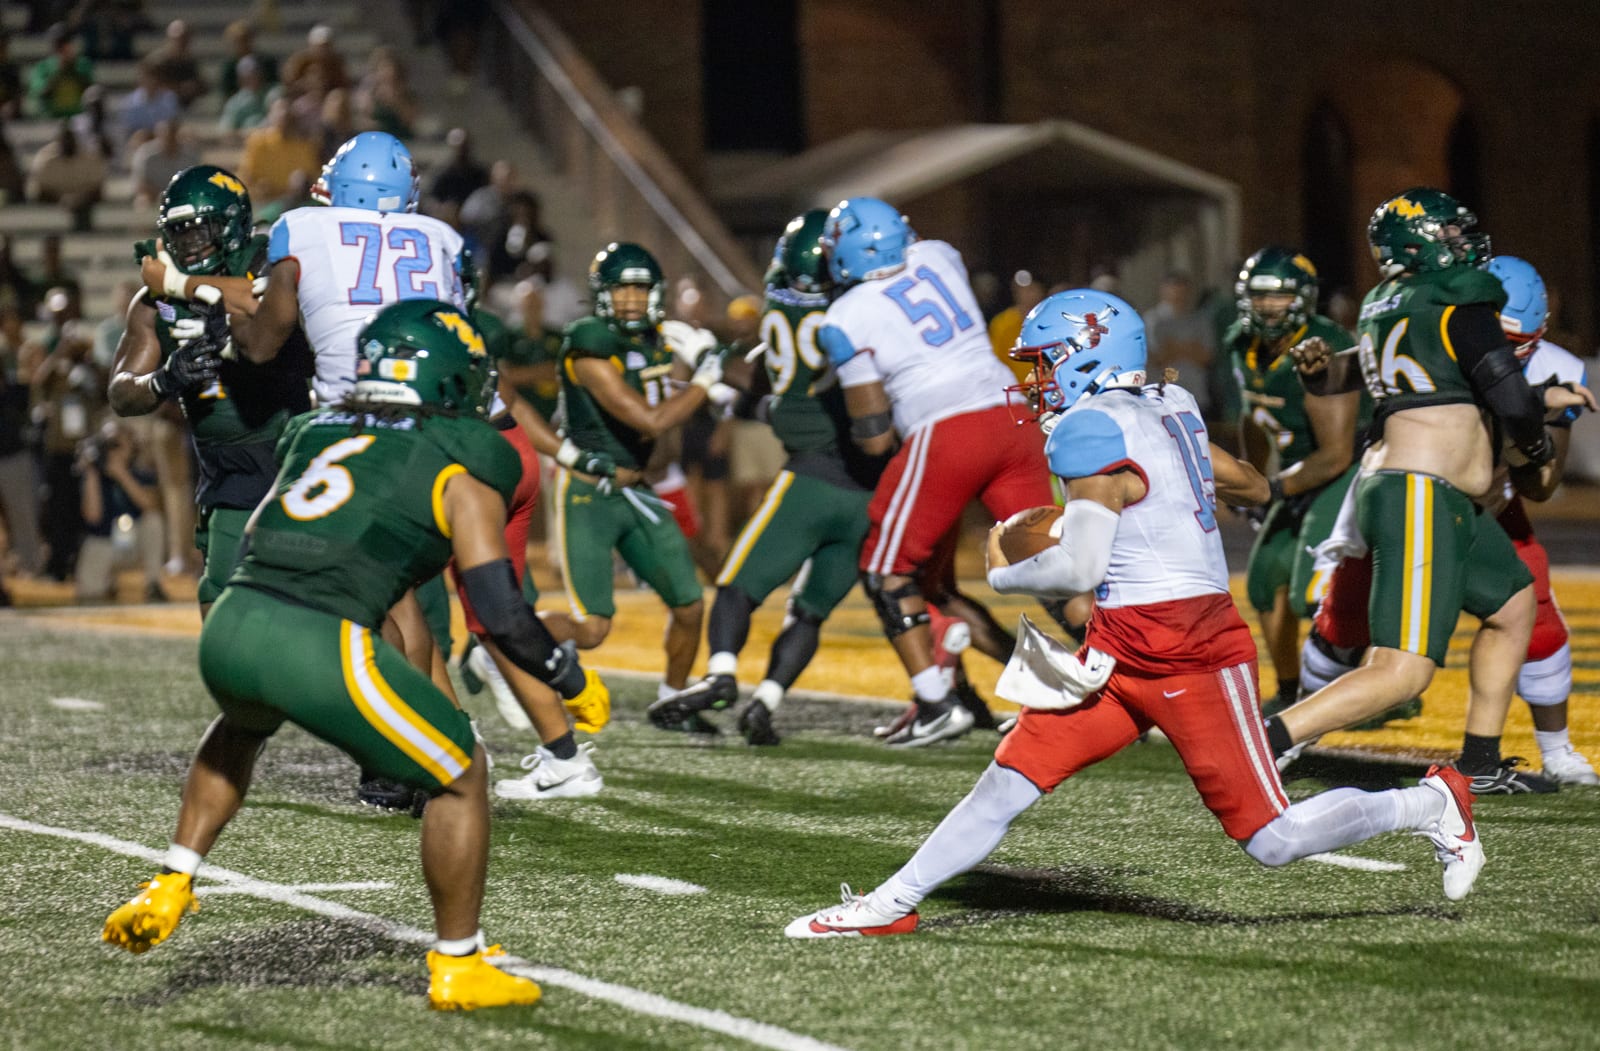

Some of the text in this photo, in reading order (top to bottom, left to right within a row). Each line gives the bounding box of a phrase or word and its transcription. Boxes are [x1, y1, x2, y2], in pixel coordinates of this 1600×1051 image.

[339, 221, 439, 305] 72
[881, 264, 975, 347] 51
[281, 434, 376, 521] 6
[1161, 410, 1216, 533] 15
